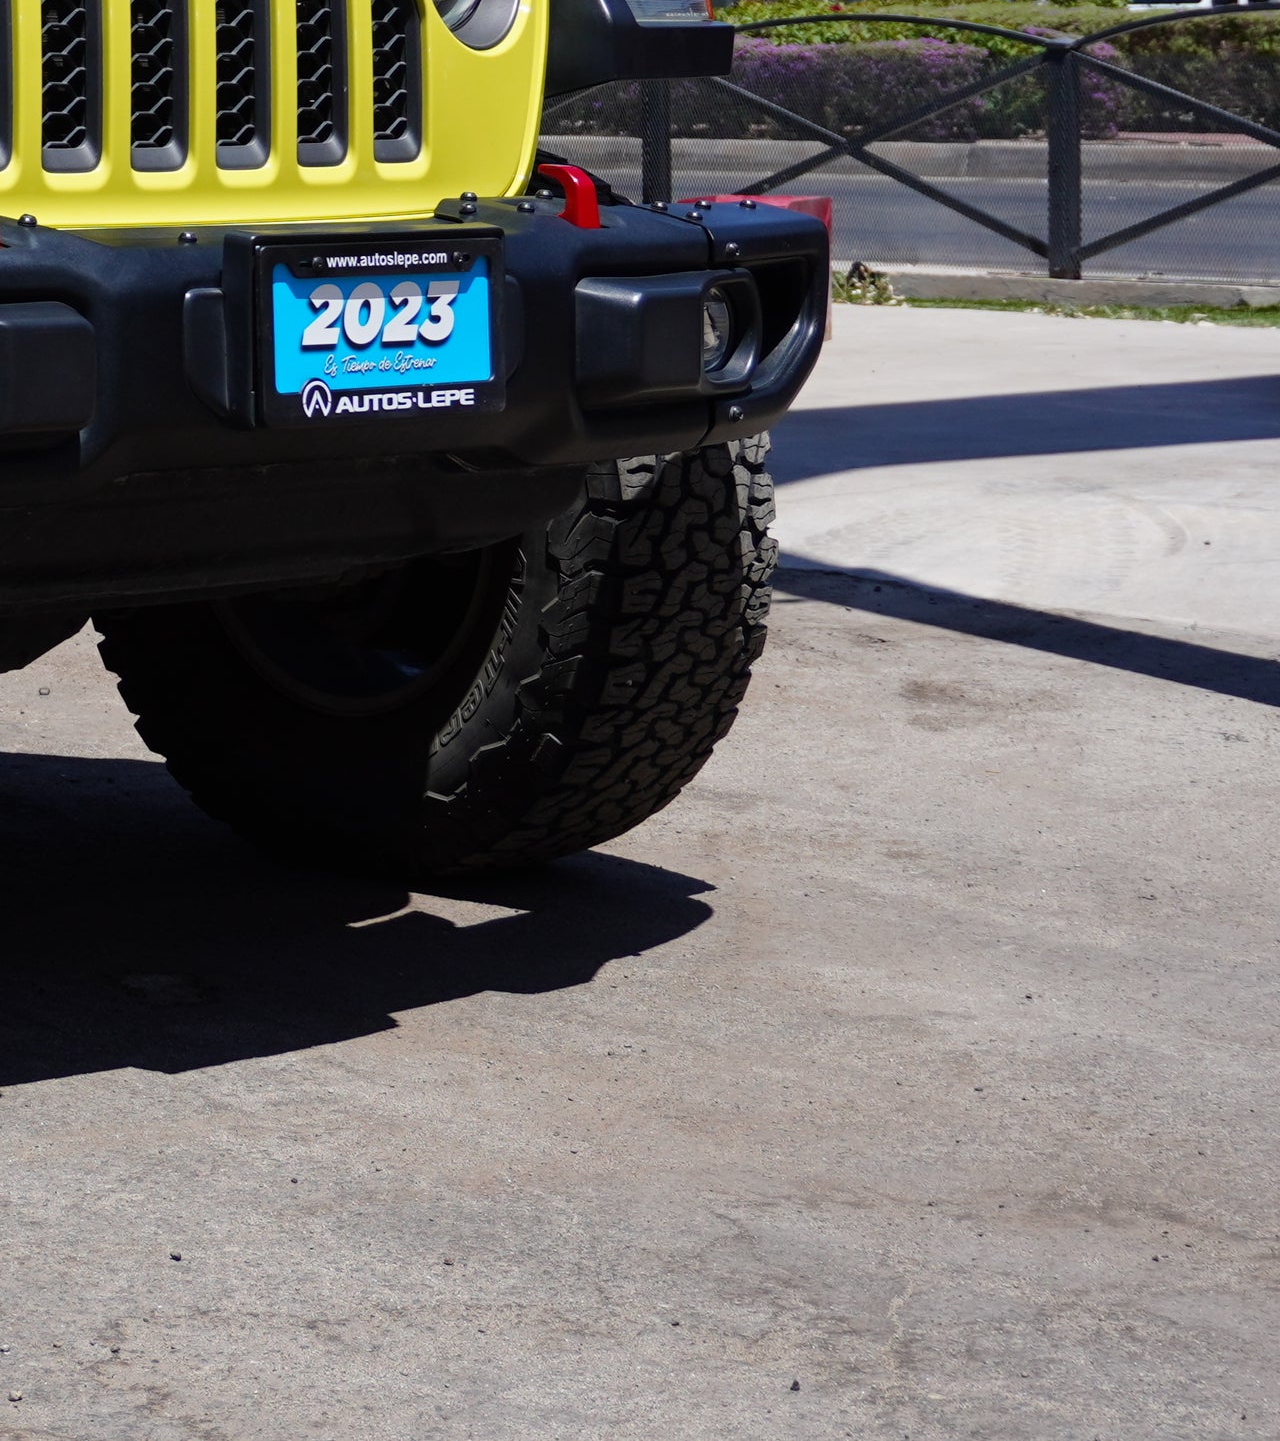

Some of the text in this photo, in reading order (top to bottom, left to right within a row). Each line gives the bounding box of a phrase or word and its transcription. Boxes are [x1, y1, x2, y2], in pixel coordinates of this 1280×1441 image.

[326, 251, 448, 269] www.autoslepe.com
[301, 280, 460, 347] 2023
[324, 351, 437, 377] Es Tiempo de Estrenar
